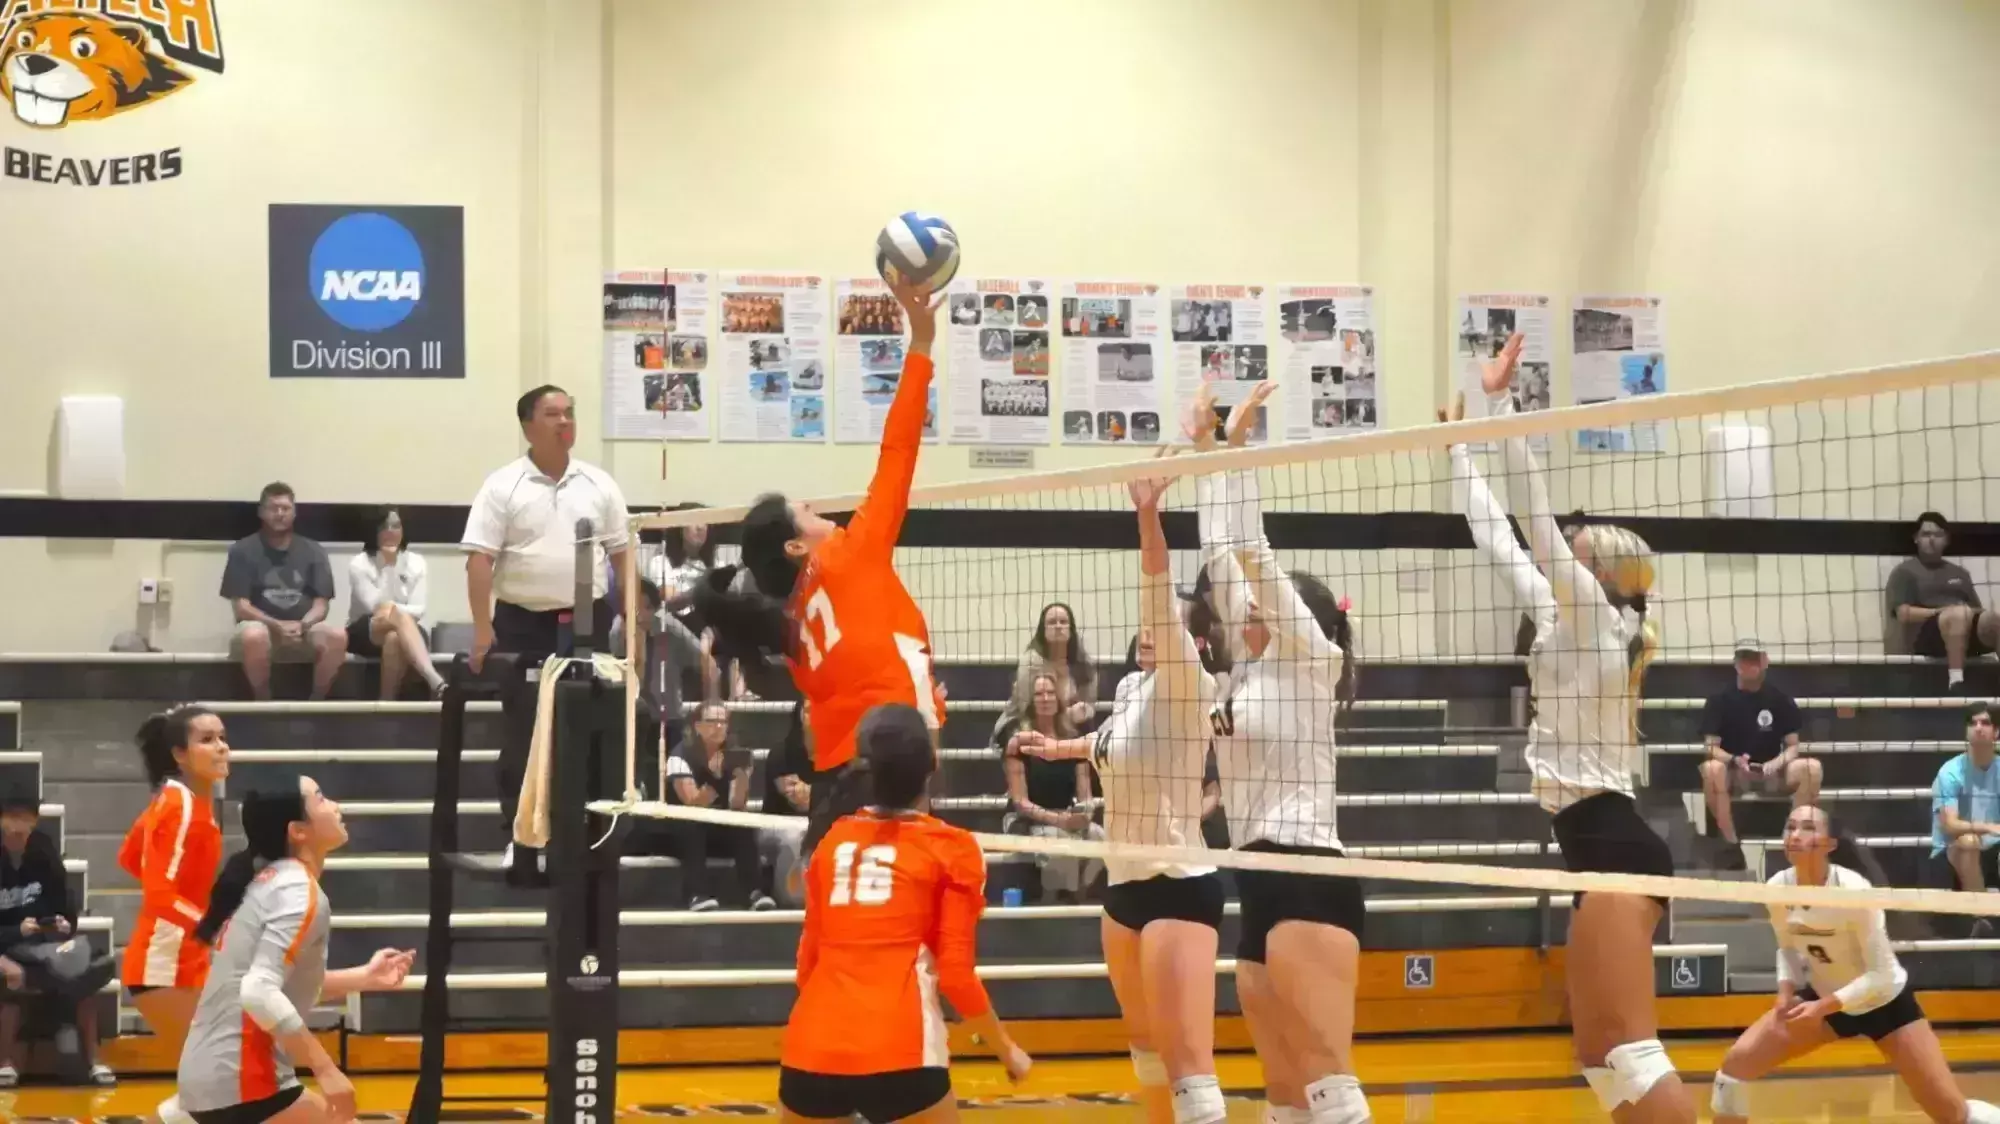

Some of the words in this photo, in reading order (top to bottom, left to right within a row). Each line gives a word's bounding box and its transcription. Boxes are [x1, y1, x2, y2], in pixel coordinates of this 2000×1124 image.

[4, 146, 183, 187] BEAVERS
[320, 268, 421, 301] NCAA
[292, 339, 411, 369] Division
[422, 340, 442, 369] III
[799, 584, 842, 671] 17
[829, 841, 898, 906] 16
